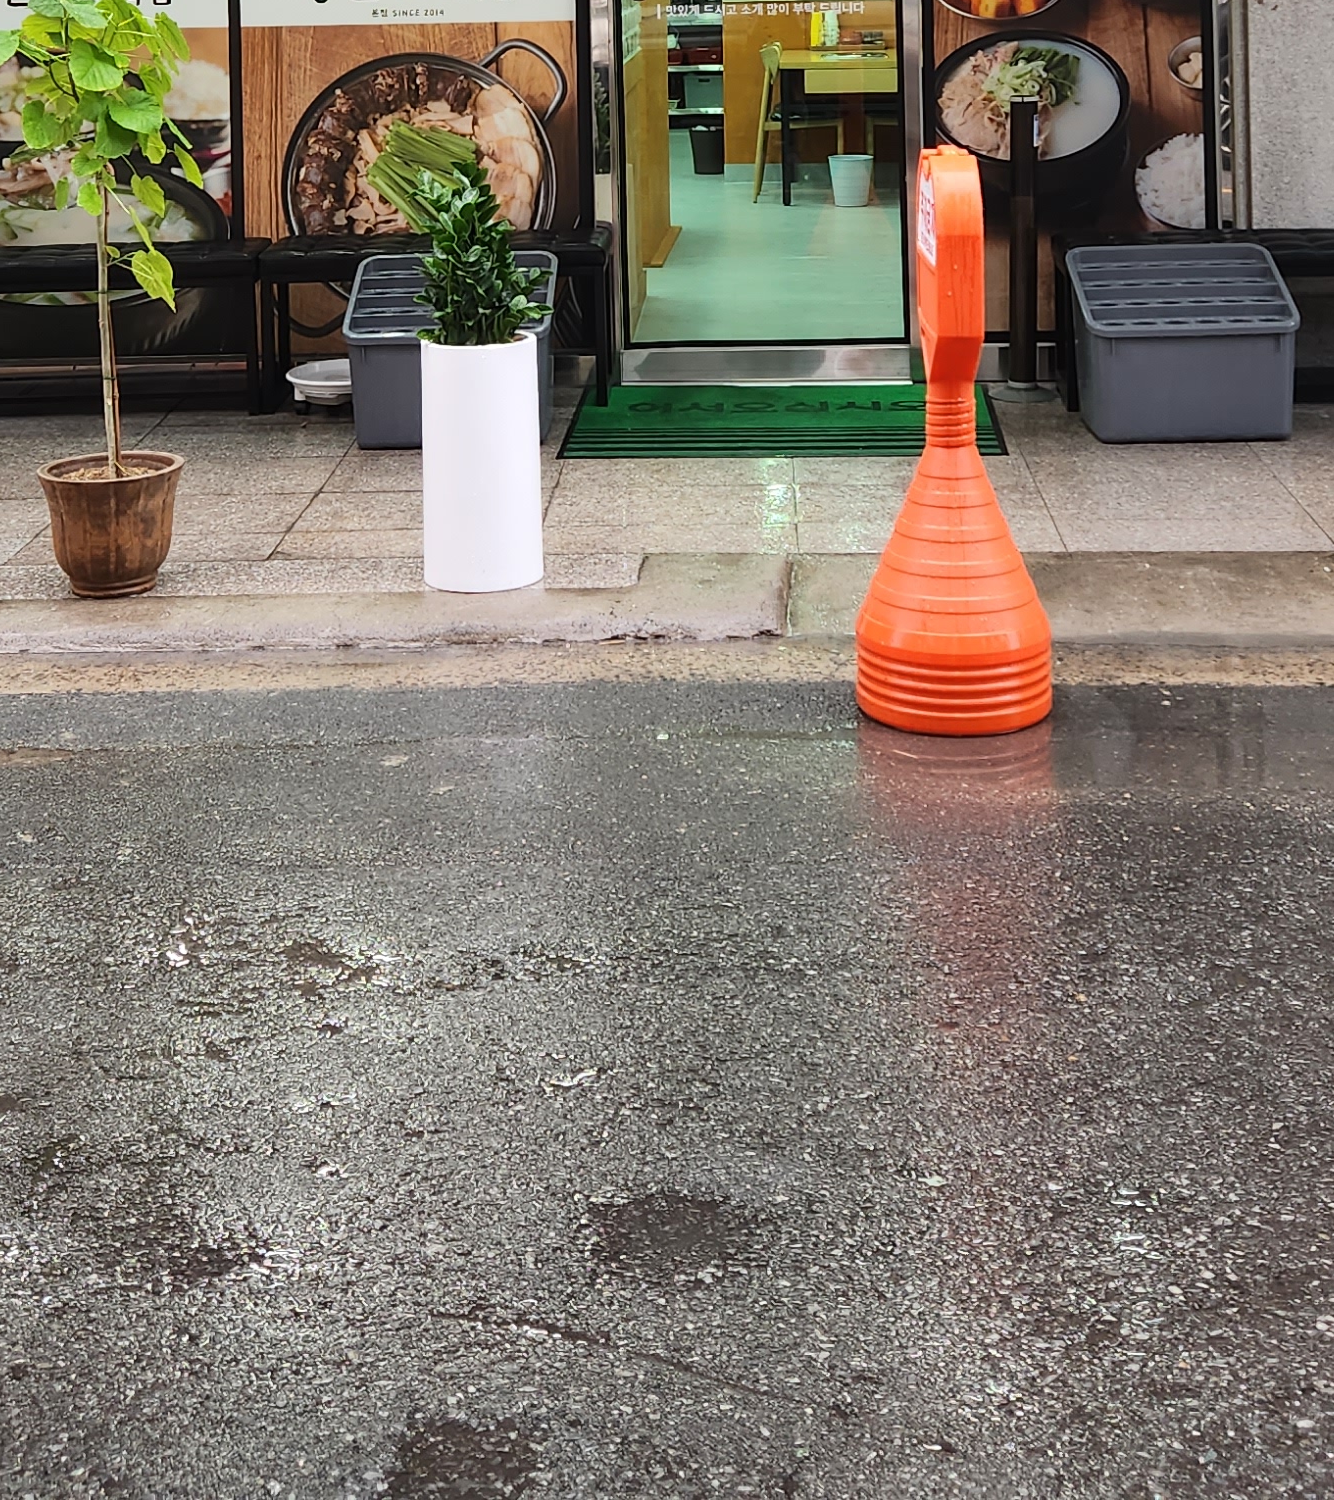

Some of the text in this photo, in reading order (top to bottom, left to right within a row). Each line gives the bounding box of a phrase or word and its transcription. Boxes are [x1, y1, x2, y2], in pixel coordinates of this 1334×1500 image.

[392, 8, 419, 18] SINCE
[423, 8, 445, 18] 2014
[665, 4, 701, 19] 맛있게
[741, 3, 763, 16] 소개
[766, 3, 789, 16] 많이
[792, 2, 816, 15] 부탁
[819, 1, 865, 15] 드립니다
